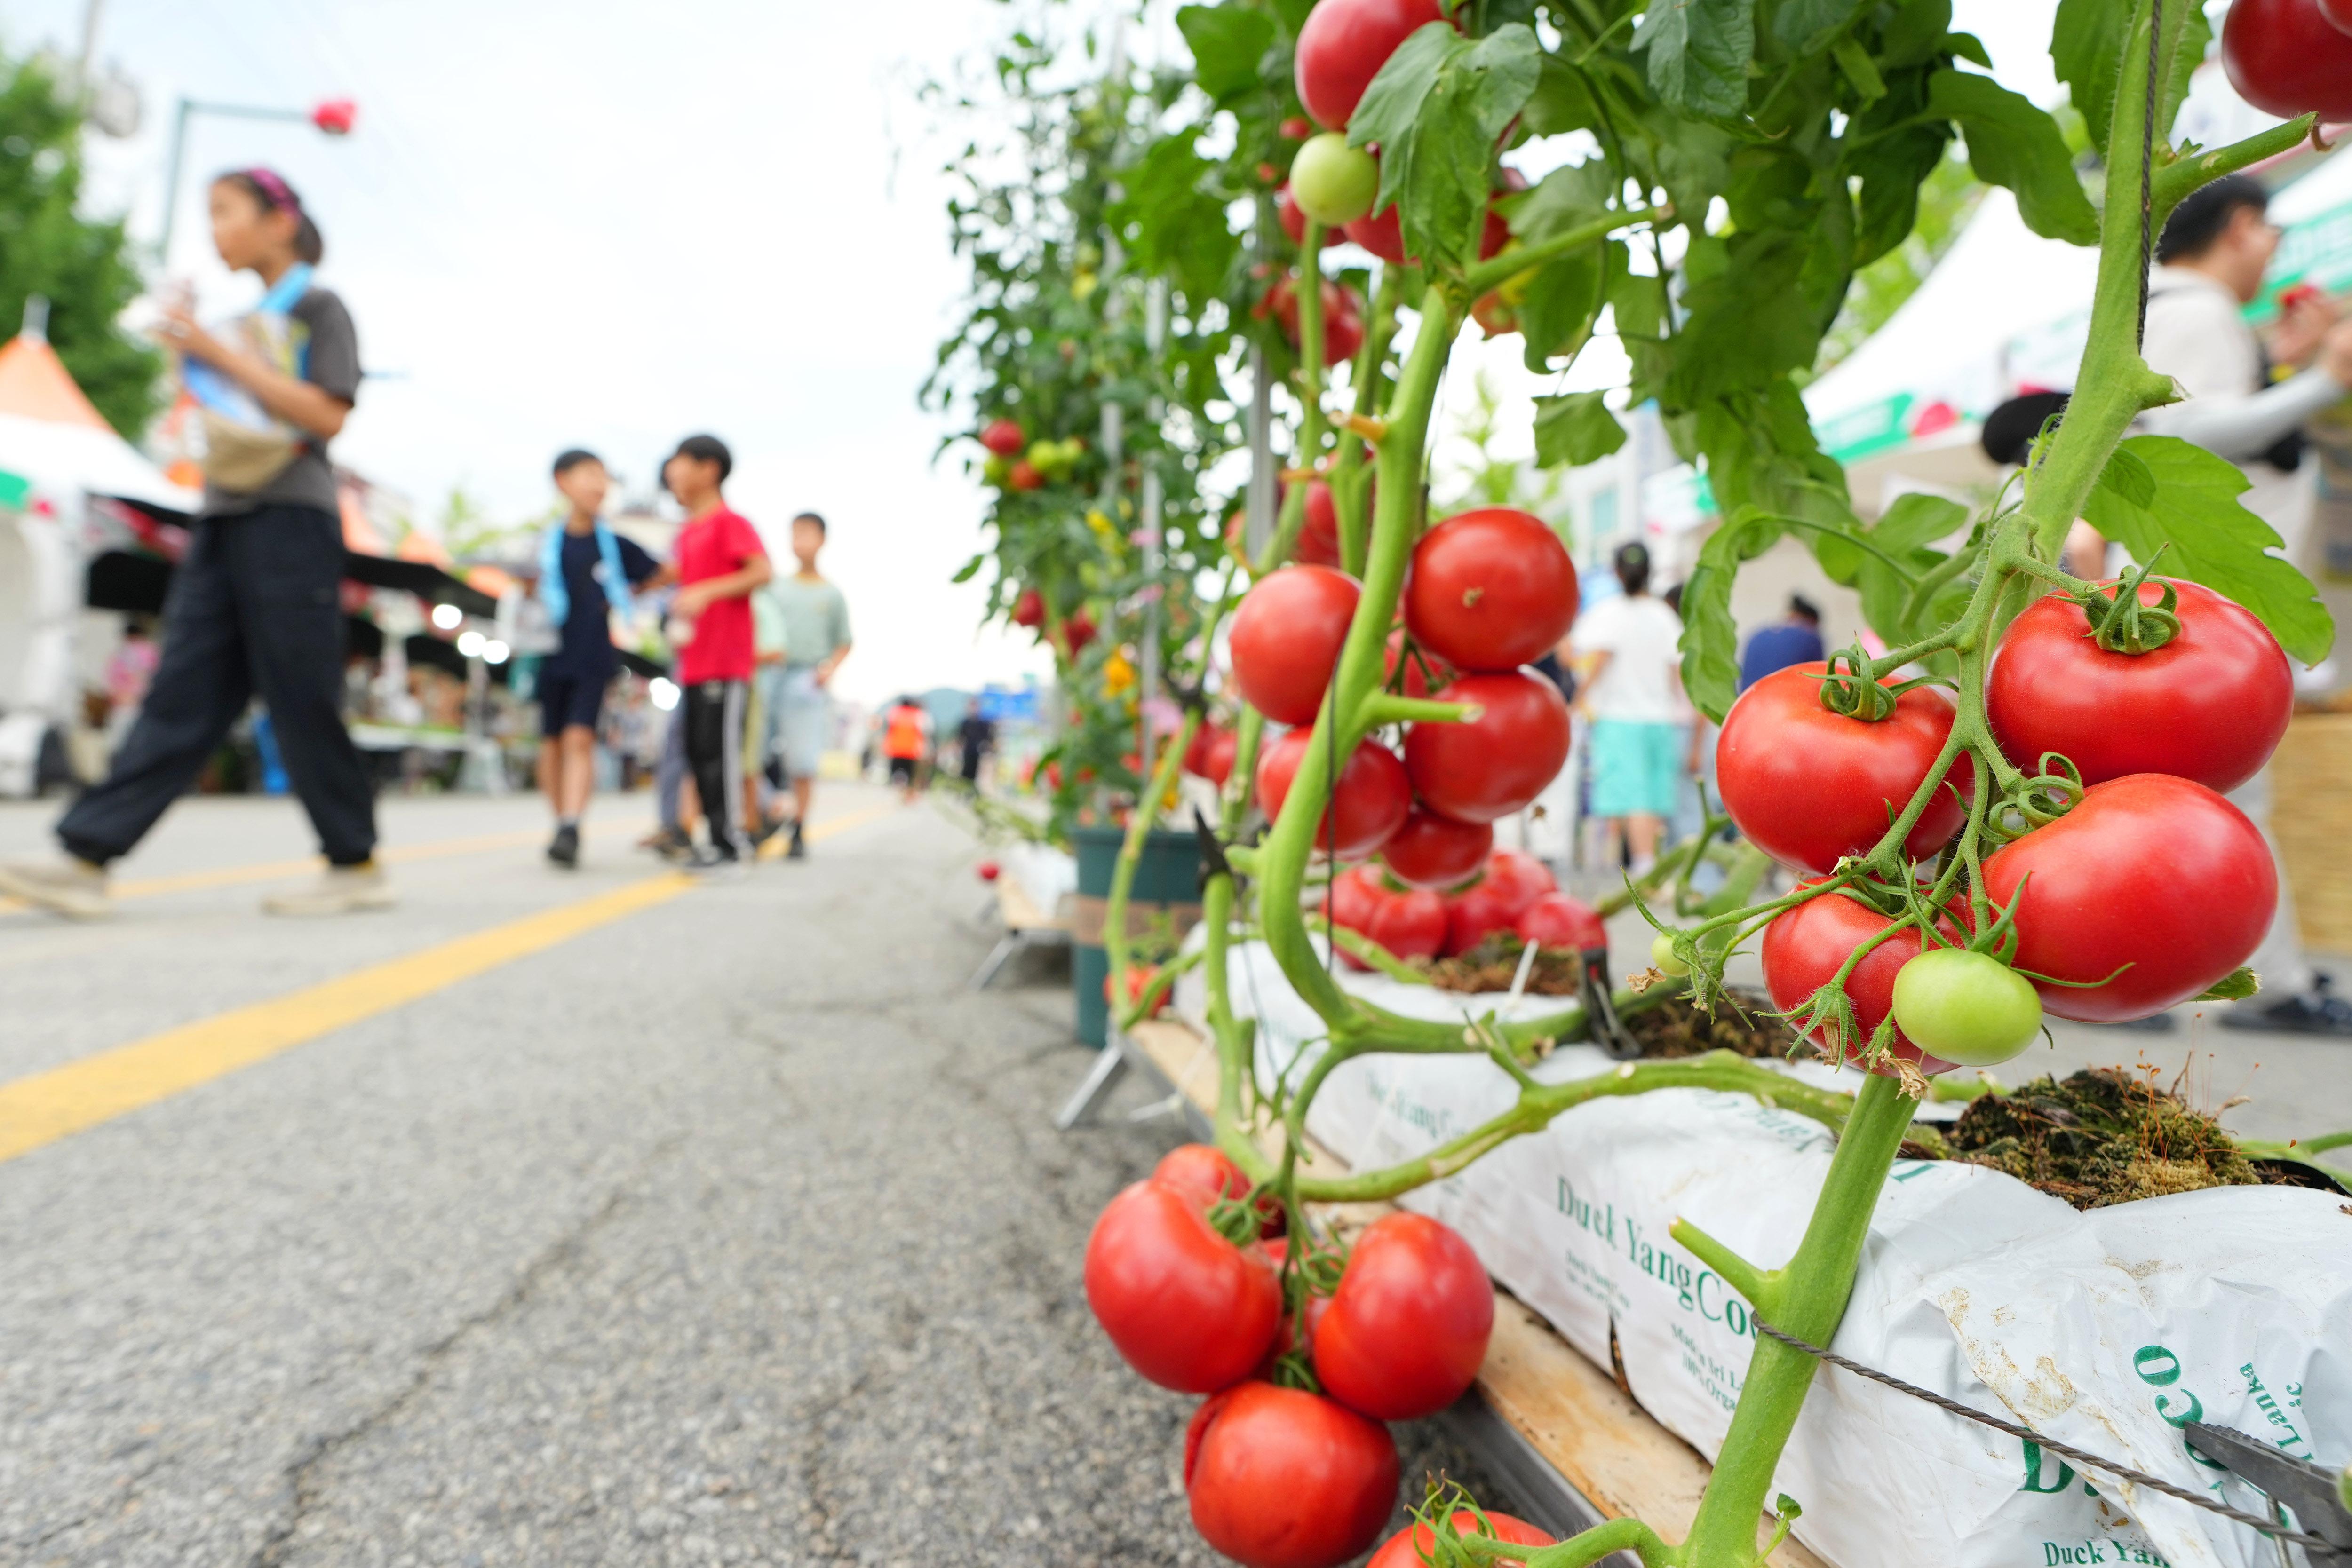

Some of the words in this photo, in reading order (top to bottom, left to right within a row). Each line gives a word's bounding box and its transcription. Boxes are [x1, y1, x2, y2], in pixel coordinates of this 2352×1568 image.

[1557, 1175, 1617, 1251] Duck
[1729, 1370, 1744, 1391] L
[2239, 1362, 2303, 1450] Lanka
[2042, 1539, 2106, 1567] Duck
